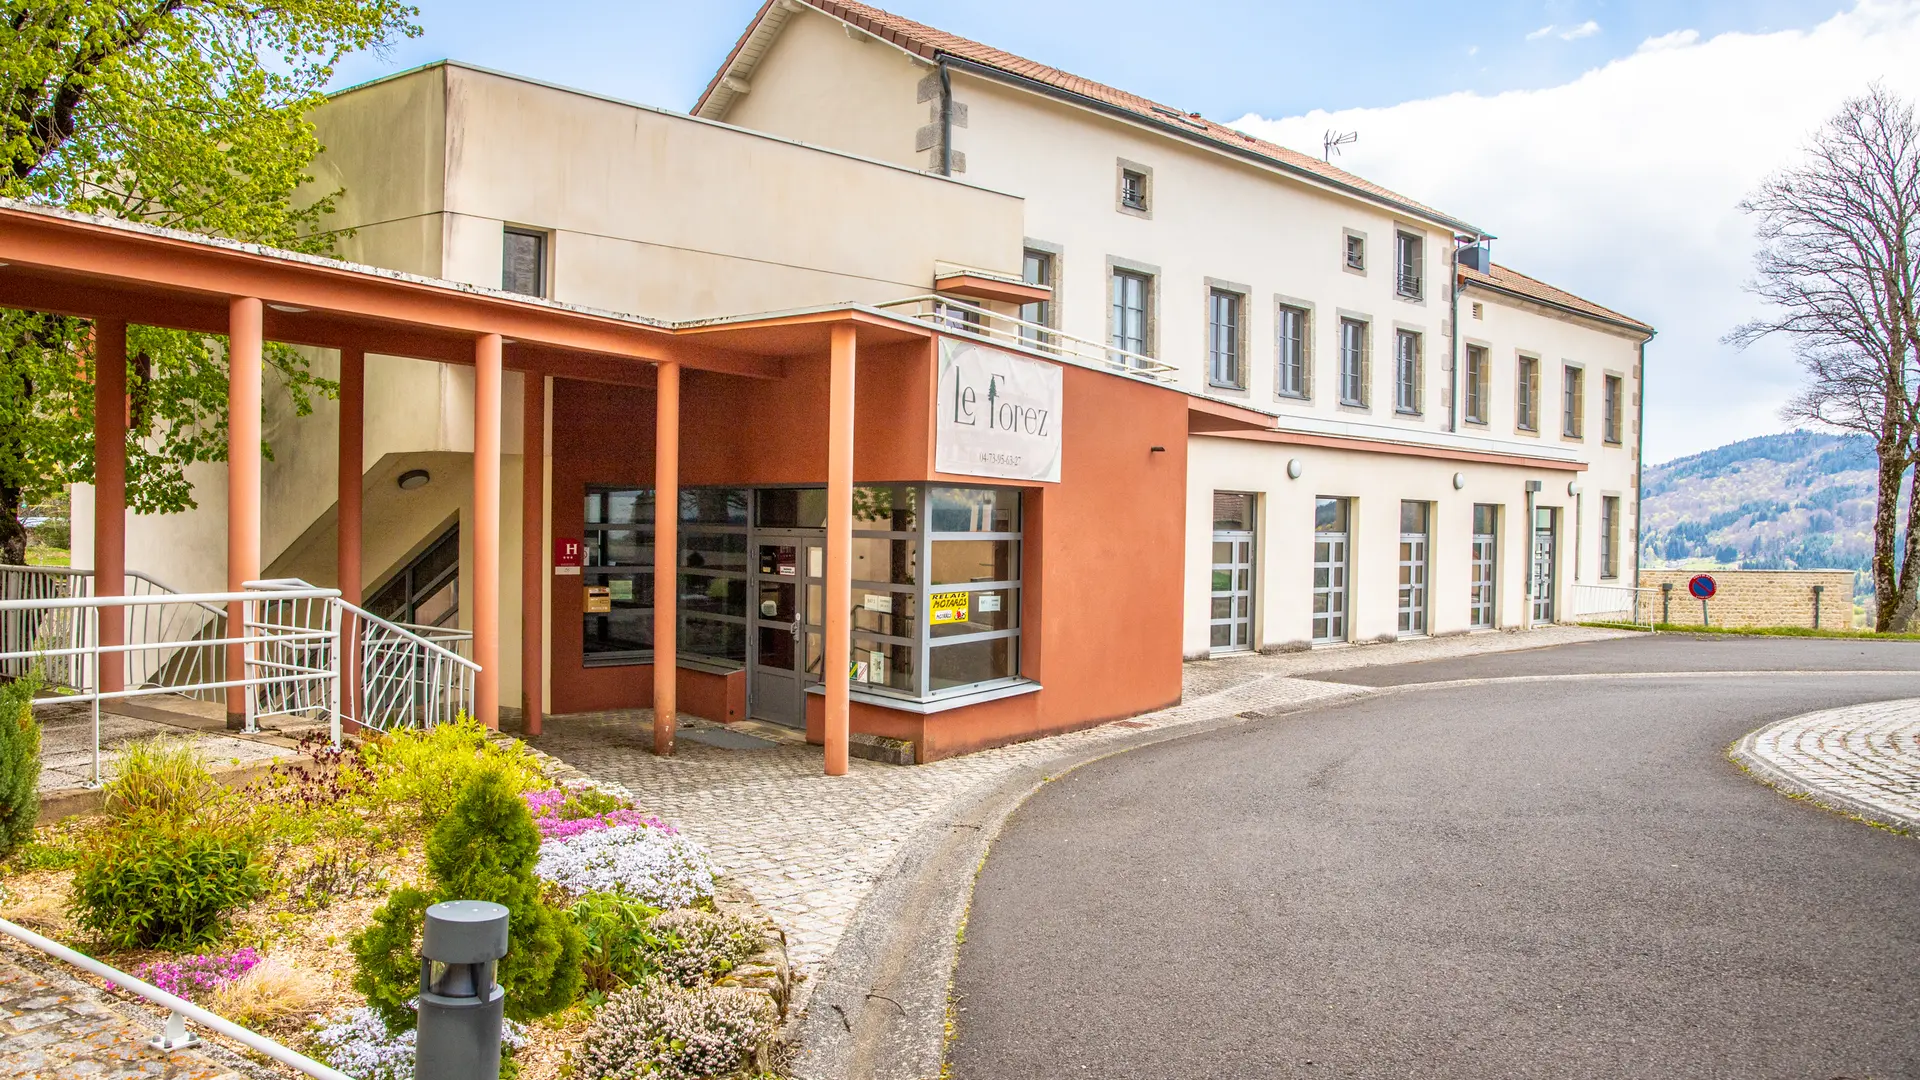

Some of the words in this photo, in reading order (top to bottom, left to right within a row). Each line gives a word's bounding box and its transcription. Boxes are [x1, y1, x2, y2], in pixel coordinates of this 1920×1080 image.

[954, 365, 976, 425] Le
[987, 373, 1048, 437] Forez
[566, 543, 578, 555] H
